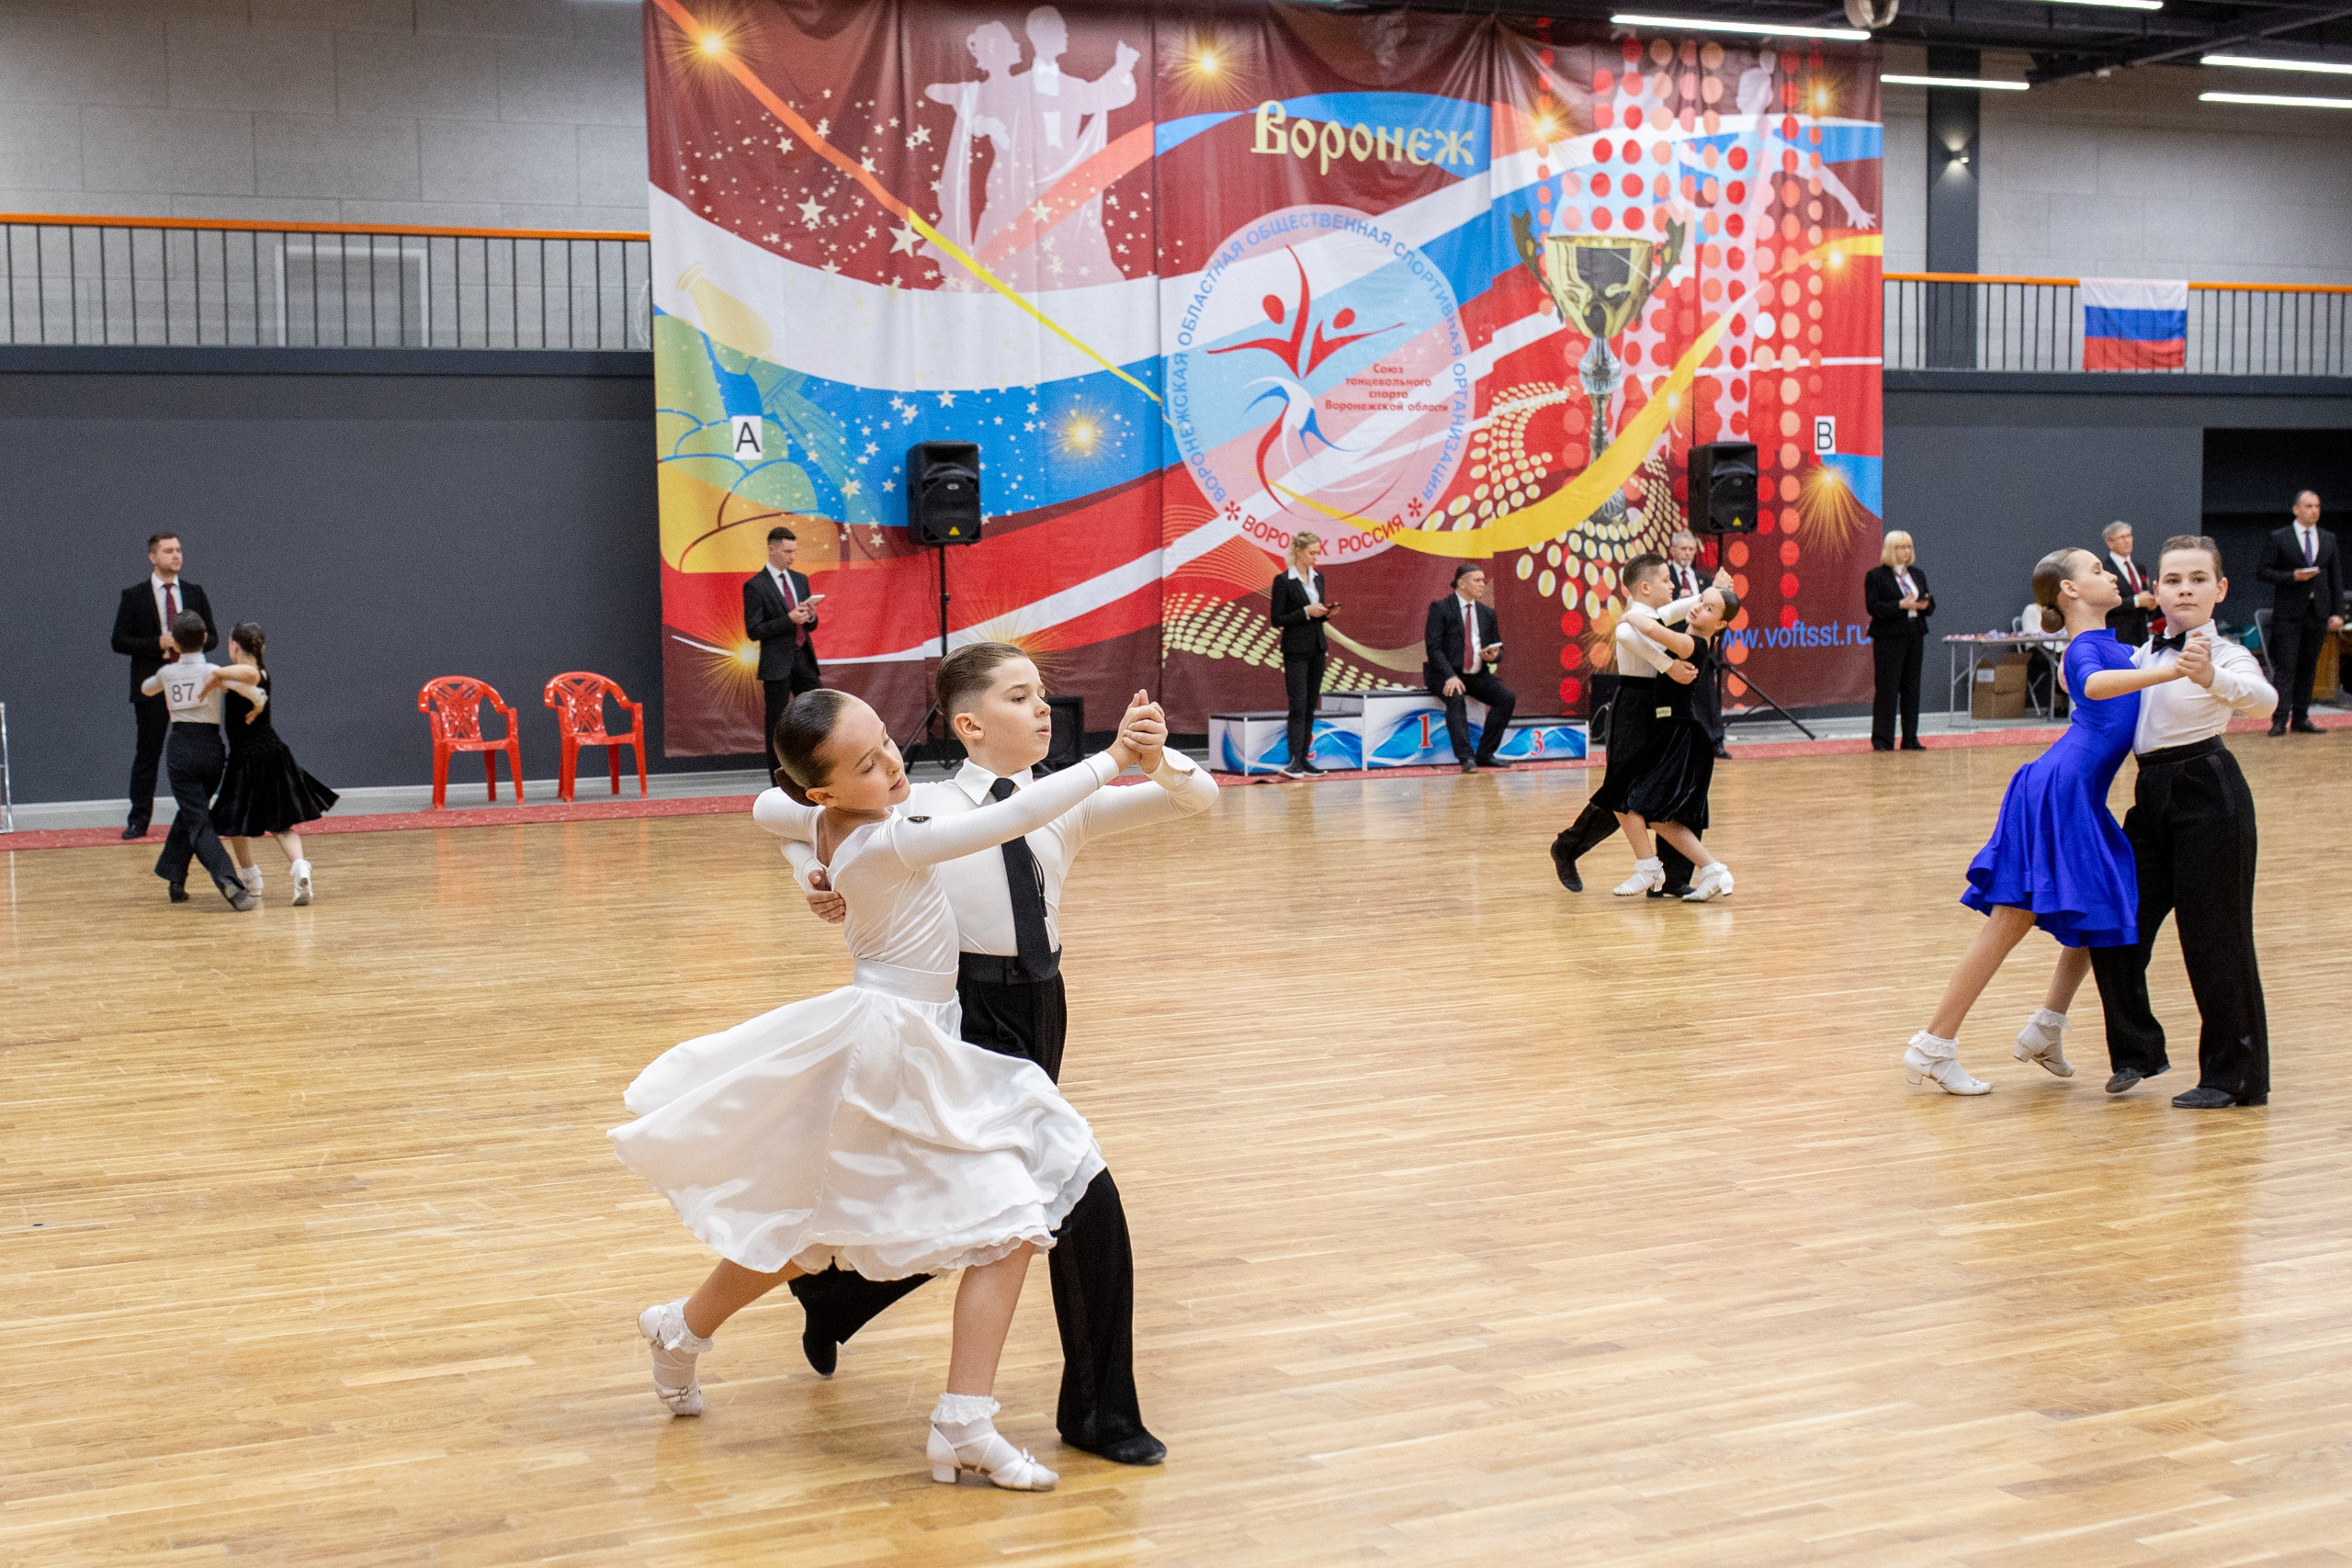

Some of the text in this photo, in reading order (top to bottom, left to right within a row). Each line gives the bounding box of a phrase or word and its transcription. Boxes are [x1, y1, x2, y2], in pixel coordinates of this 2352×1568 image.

[1250, 99, 1475, 176] Воронеж
[1172, 212, 1468, 502] ВОРОНЕЖСКАЯ ОБЛАСТНАЯ ОБЩЕСТВЕННАЯ СПОРТИВНАЯ ОРГАНИЗАЦИЯ
[1373, 363, 1404, 374] Союз
[1345, 378, 1431, 388] танцевального
[1369, 390, 1408, 401] спорта
[1325, 400, 1403, 412] Воронежской
[735, 422, 761, 453] A
[1817, 422, 1833, 450] B
[1339, 514, 1406, 555] РОССИЯ
[172, 682, 195, 703] 87
[1418, 714, 1432, 749] 1
[1530, 729, 1544, 757] 3
